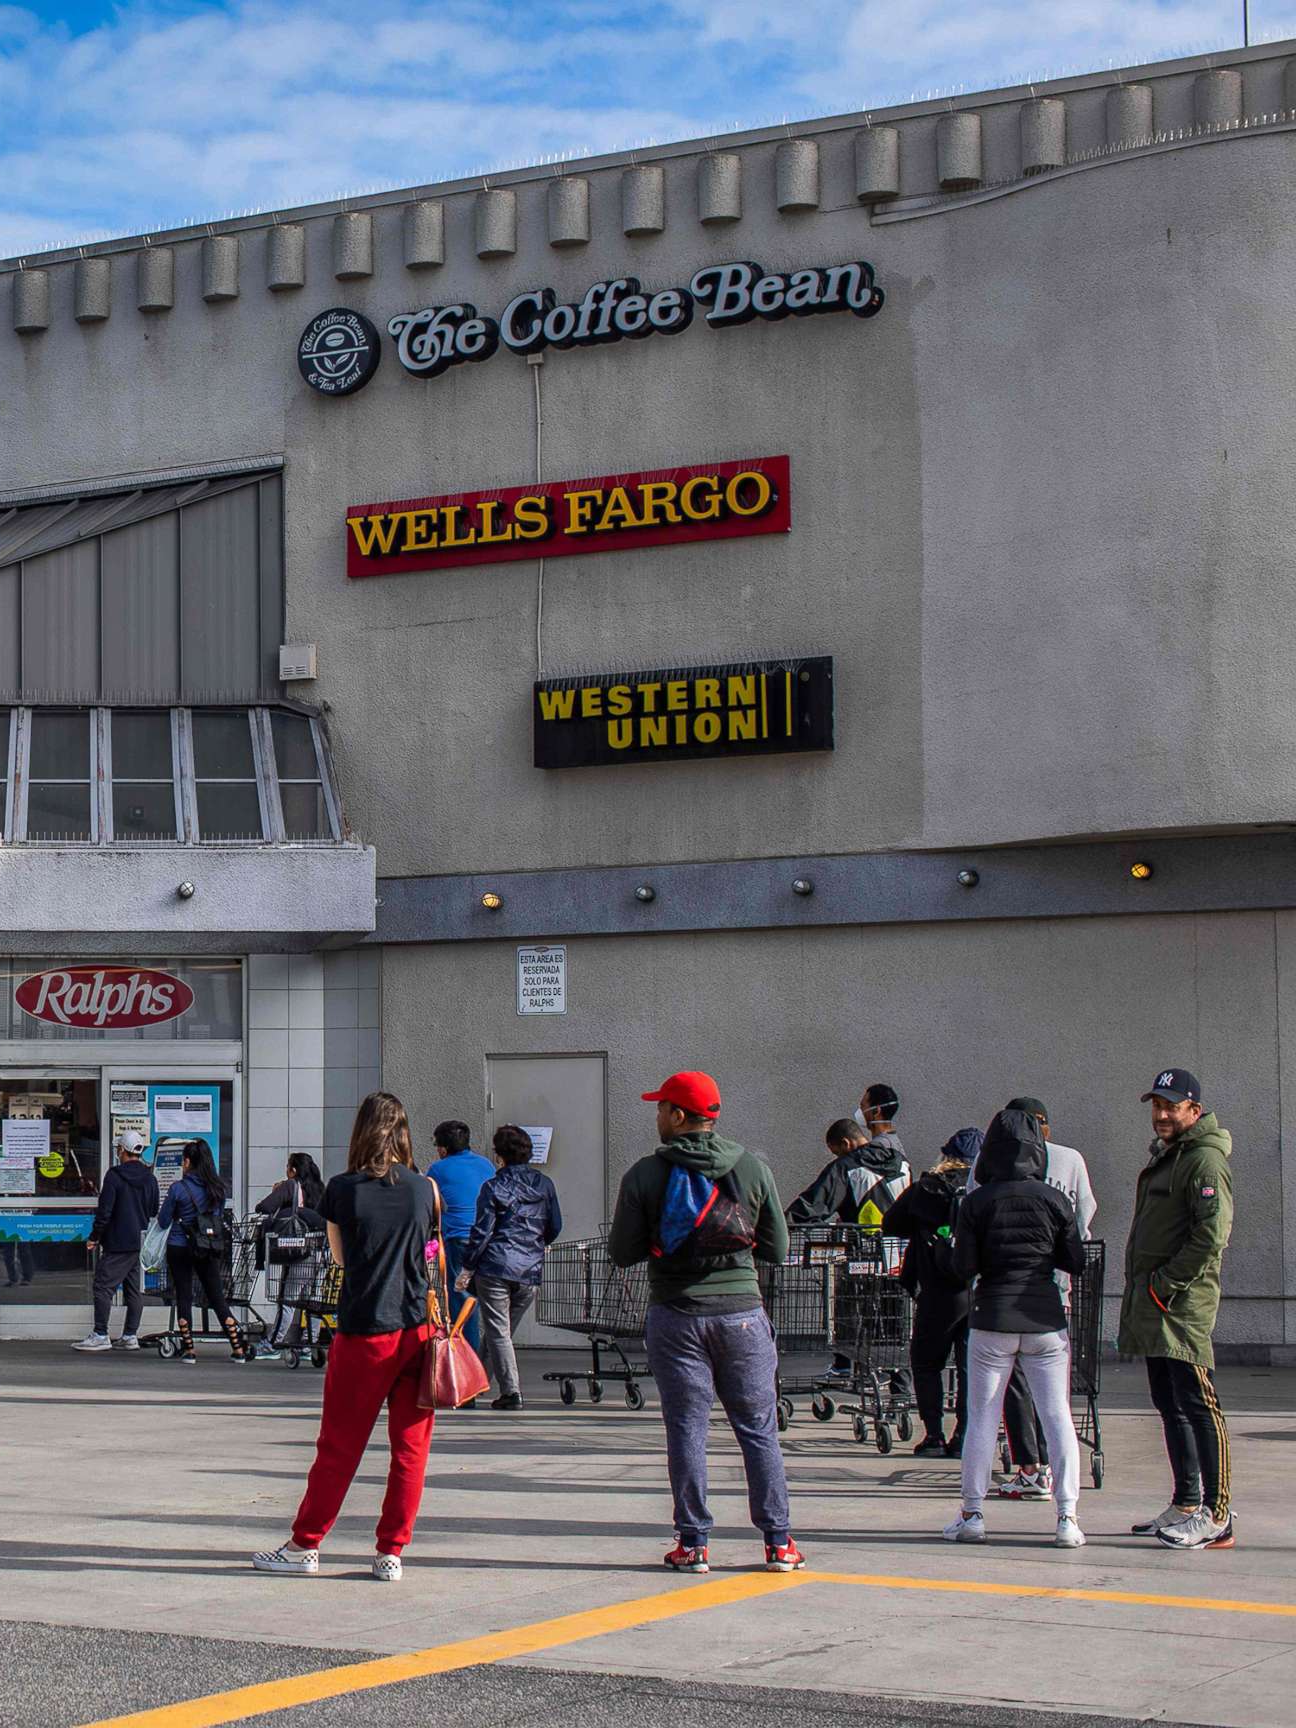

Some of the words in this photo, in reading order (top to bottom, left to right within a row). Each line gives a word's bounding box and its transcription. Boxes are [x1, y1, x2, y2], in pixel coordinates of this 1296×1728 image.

[313, 312, 346, 333] Coffee
[347, 314, 367, 346] Bean
[388, 304, 487, 371] The
[501, 277, 682, 348] Coffee
[691, 262, 873, 321] Bean
[318, 377, 336, 390] Tea
[336, 362, 363, 389] Leaf
[347, 495, 551, 557] WELLS
[563, 470, 772, 537] FARGO
[538, 674, 757, 721] WESTERN
[607, 709, 757, 750] UNION
[520, 955, 536, 964] ESTA
[536, 955, 554, 964] AREA
[554, 954, 564, 963] ES
[523, 966, 560, 975] RESERVADA
[522, 988, 552, 997] CLIENTES
[552, 987, 561, 996] DE
[524, 977, 542, 986] SOLO
[542, 977, 559, 985] PARA
[32, 970, 177, 1027] Ralphs
[529, 999, 555, 1007] RALPHS
